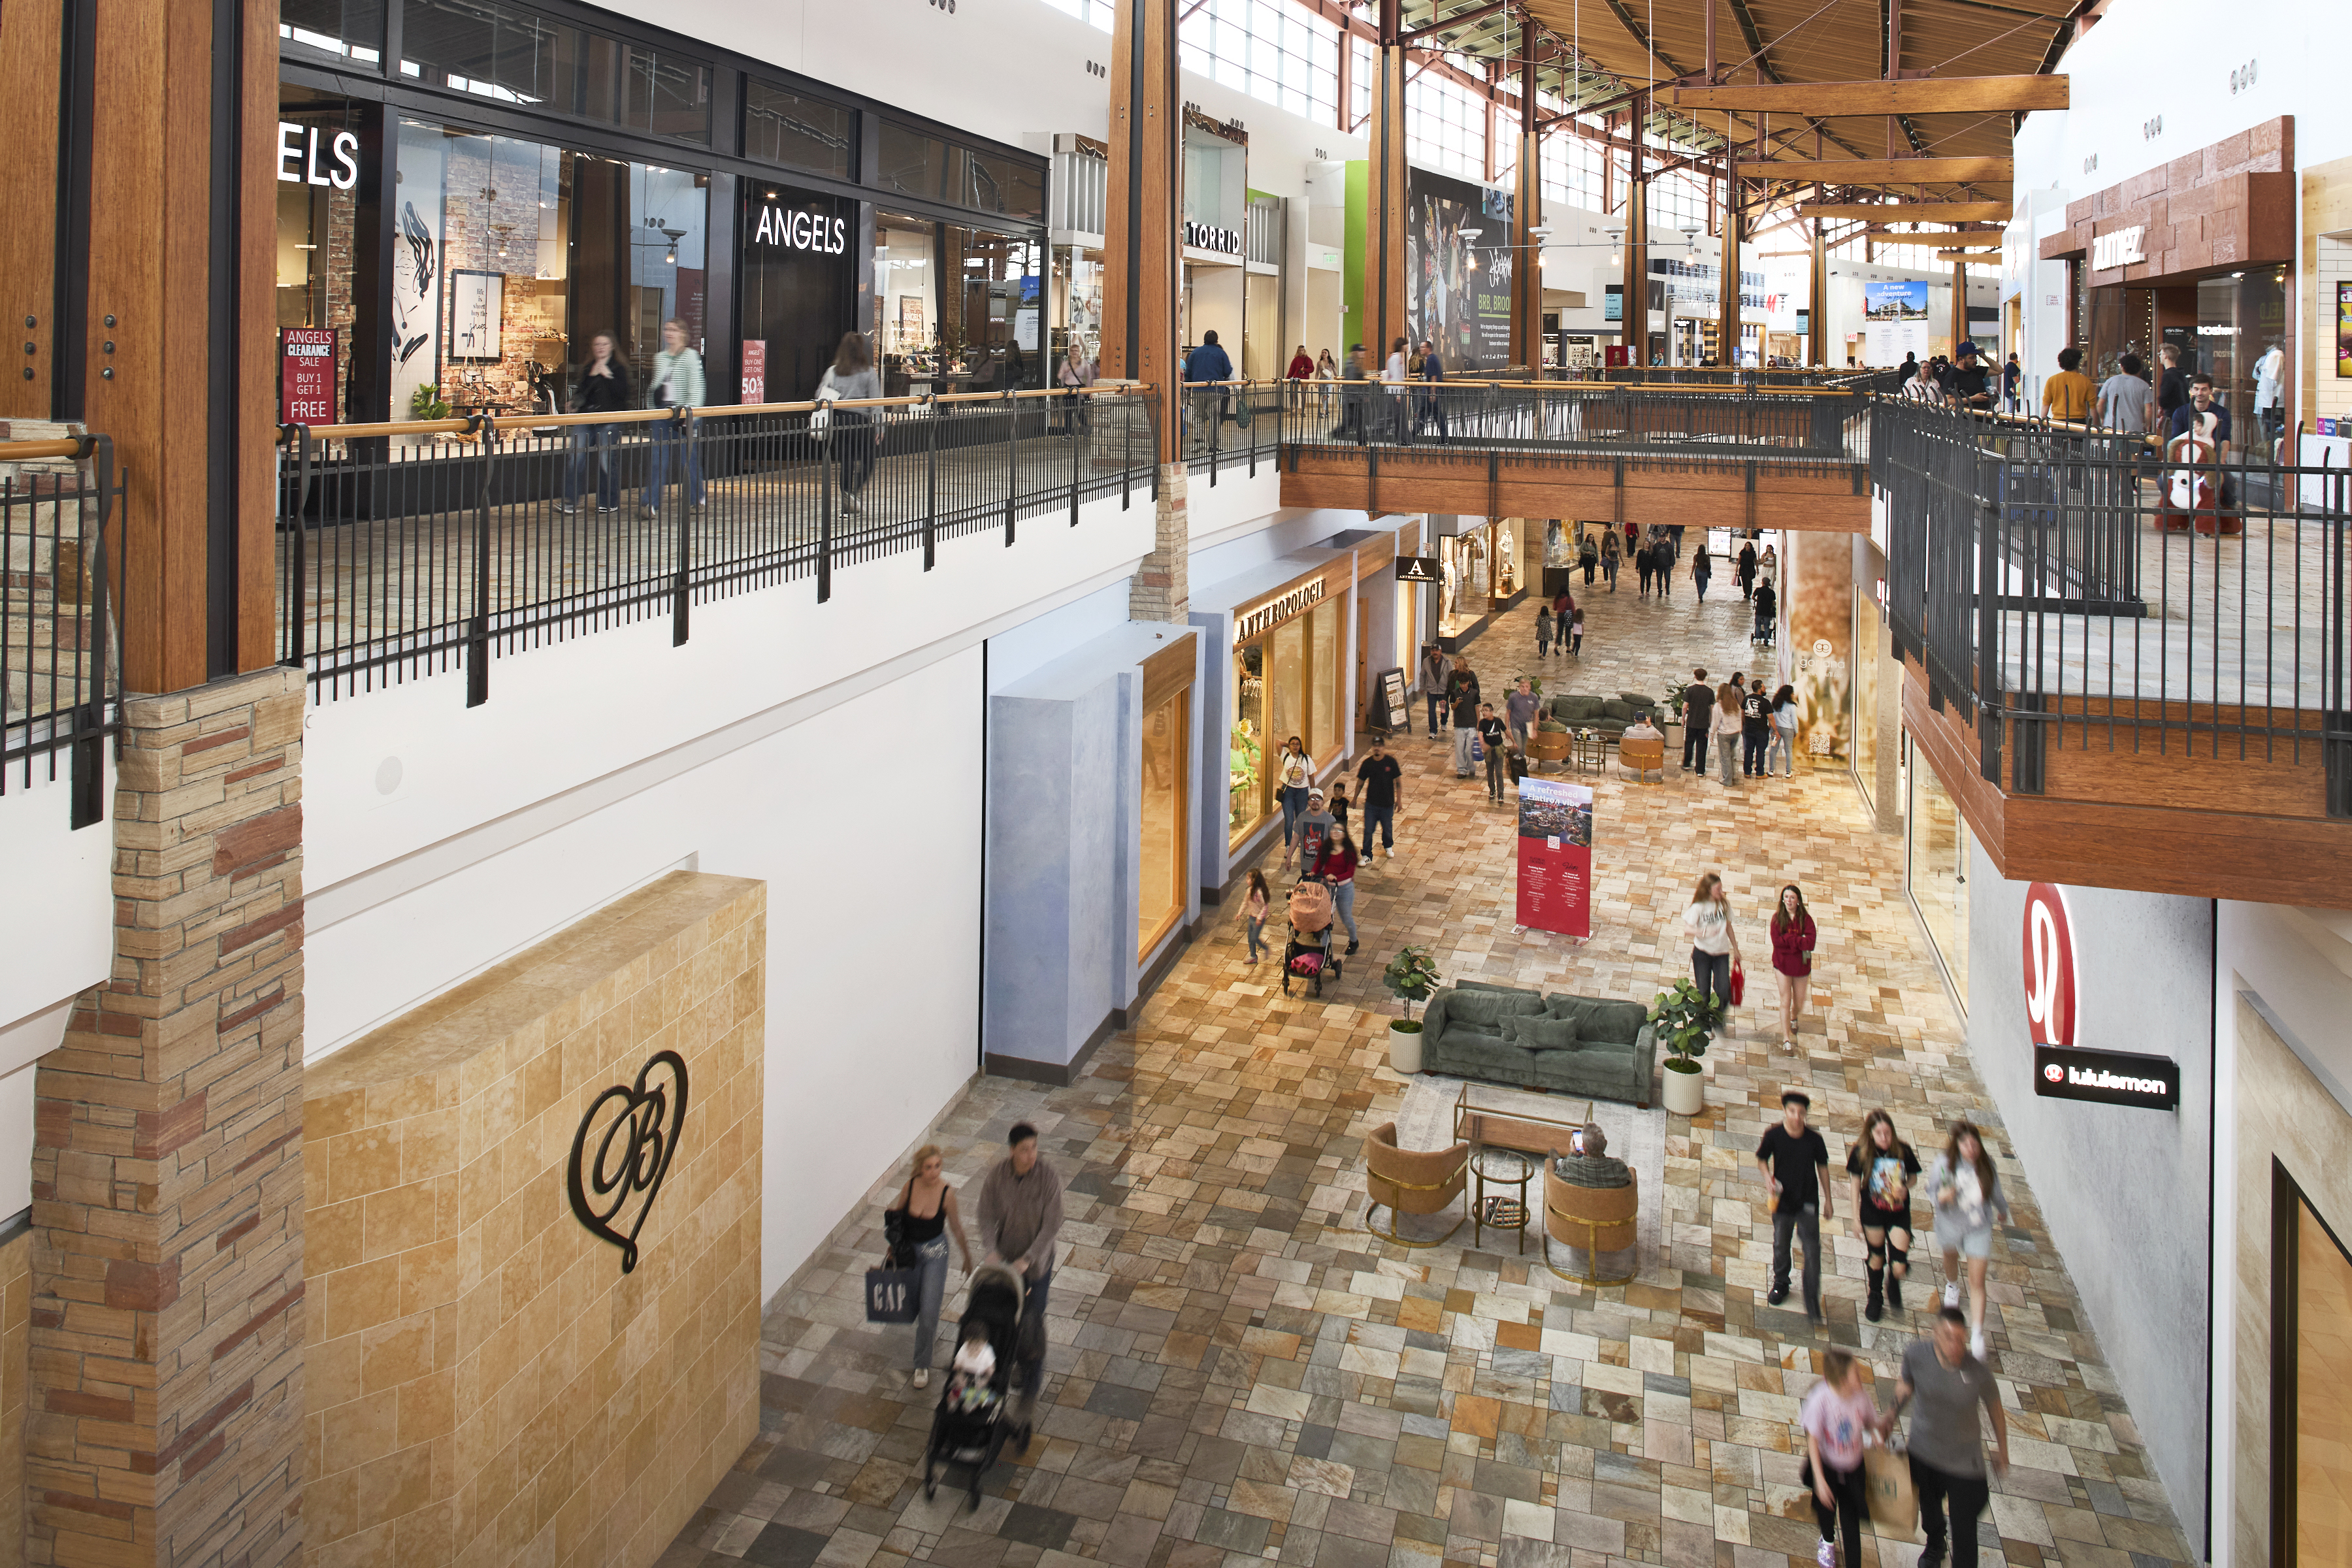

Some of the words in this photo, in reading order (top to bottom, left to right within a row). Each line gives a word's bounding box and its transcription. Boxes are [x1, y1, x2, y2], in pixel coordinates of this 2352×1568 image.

[277, 122, 359, 189] ELS
[755, 205, 845, 255] ANGELS
[1189, 221, 1240, 253] TORRID
[1478, 294, 1492, 313] BRB,
[903, 313, 922, 321] ANGELS
[287, 331, 332, 344] ANGELS
[287, 344, 330, 356] CLEARANCE
[299, 357, 319, 367] SALE
[297, 373, 314, 383] BUY
[317, 373, 321, 383] 1
[297, 385, 314, 394] GET
[316, 385, 321, 394] 1
[291, 401, 326, 418] FREE
[1408, 559, 1425, 575] A
[1237, 578, 1326, 644] ANTHROPOLOGIE
[1800, 658, 1845, 669] gorjana
[1390, 695, 1398, 705] 50
[1538, 786, 1578, 798] refreshed
[1527, 793, 1560, 804] FlatIron
[1562, 798, 1580, 808] vibe
[2068, 1066, 2166, 1095] lululemon
[874, 1282, 906, 1312] GAP
